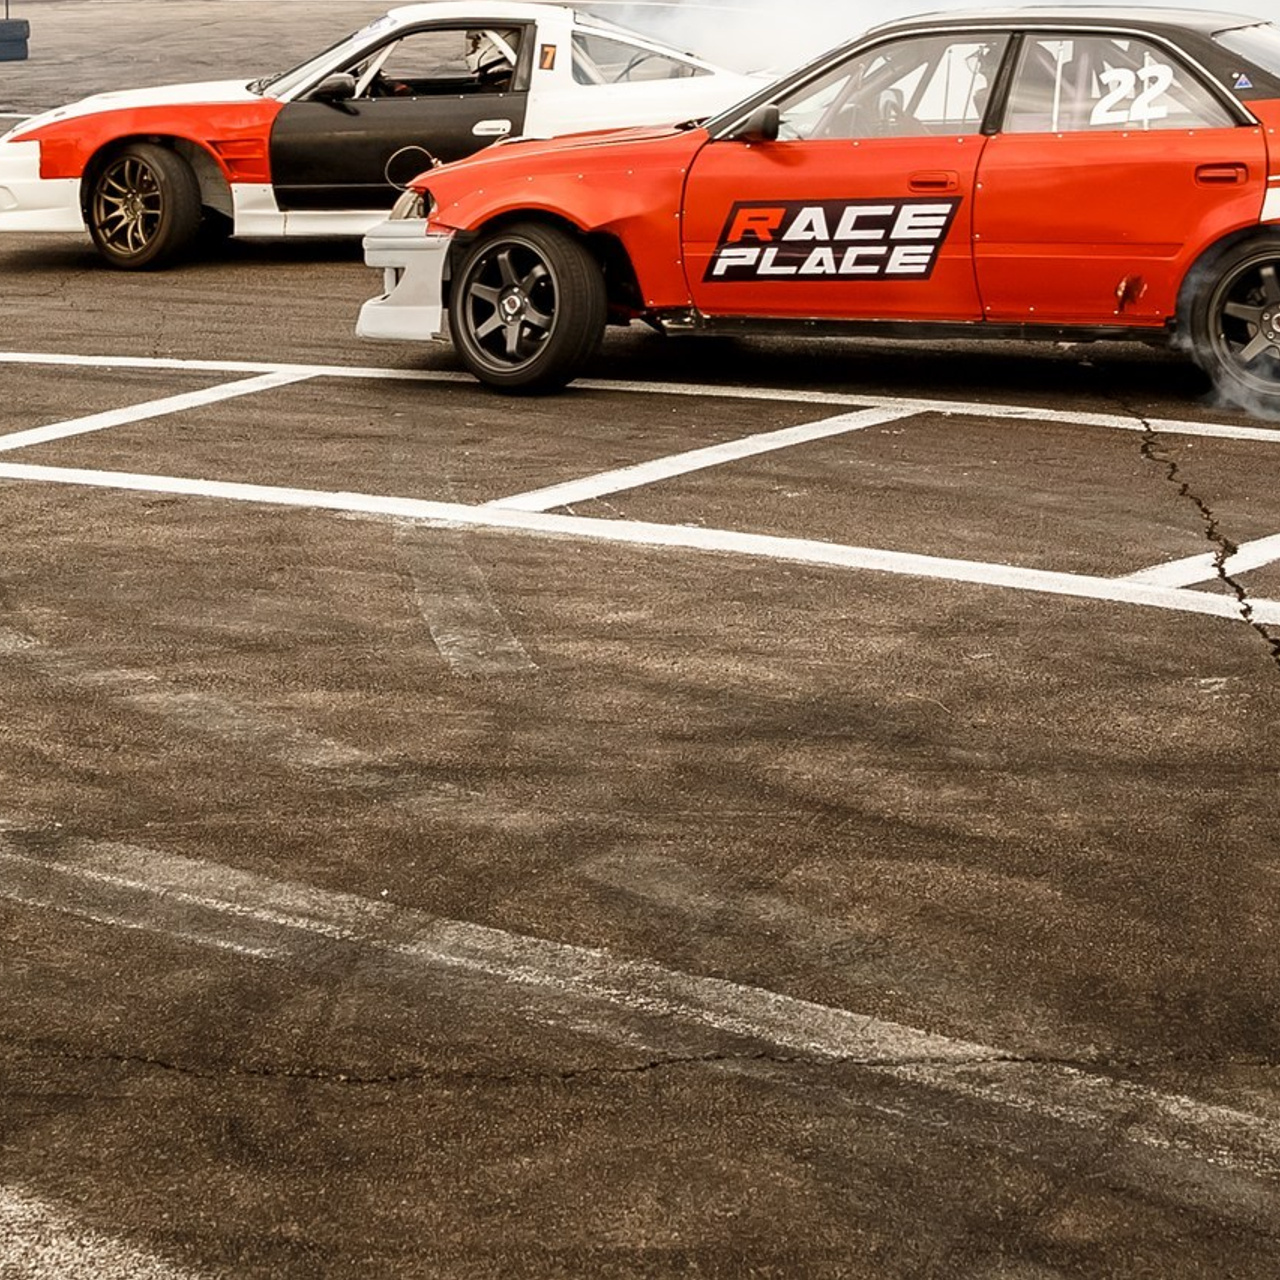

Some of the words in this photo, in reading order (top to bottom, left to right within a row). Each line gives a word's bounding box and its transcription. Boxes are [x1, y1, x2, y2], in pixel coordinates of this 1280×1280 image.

[542, 46, 556, 69] 7
[1089, 64, 1174, 126] 22
[727, 203, 953, 242] RACE
[712, 245, 935, 276] PLACE
